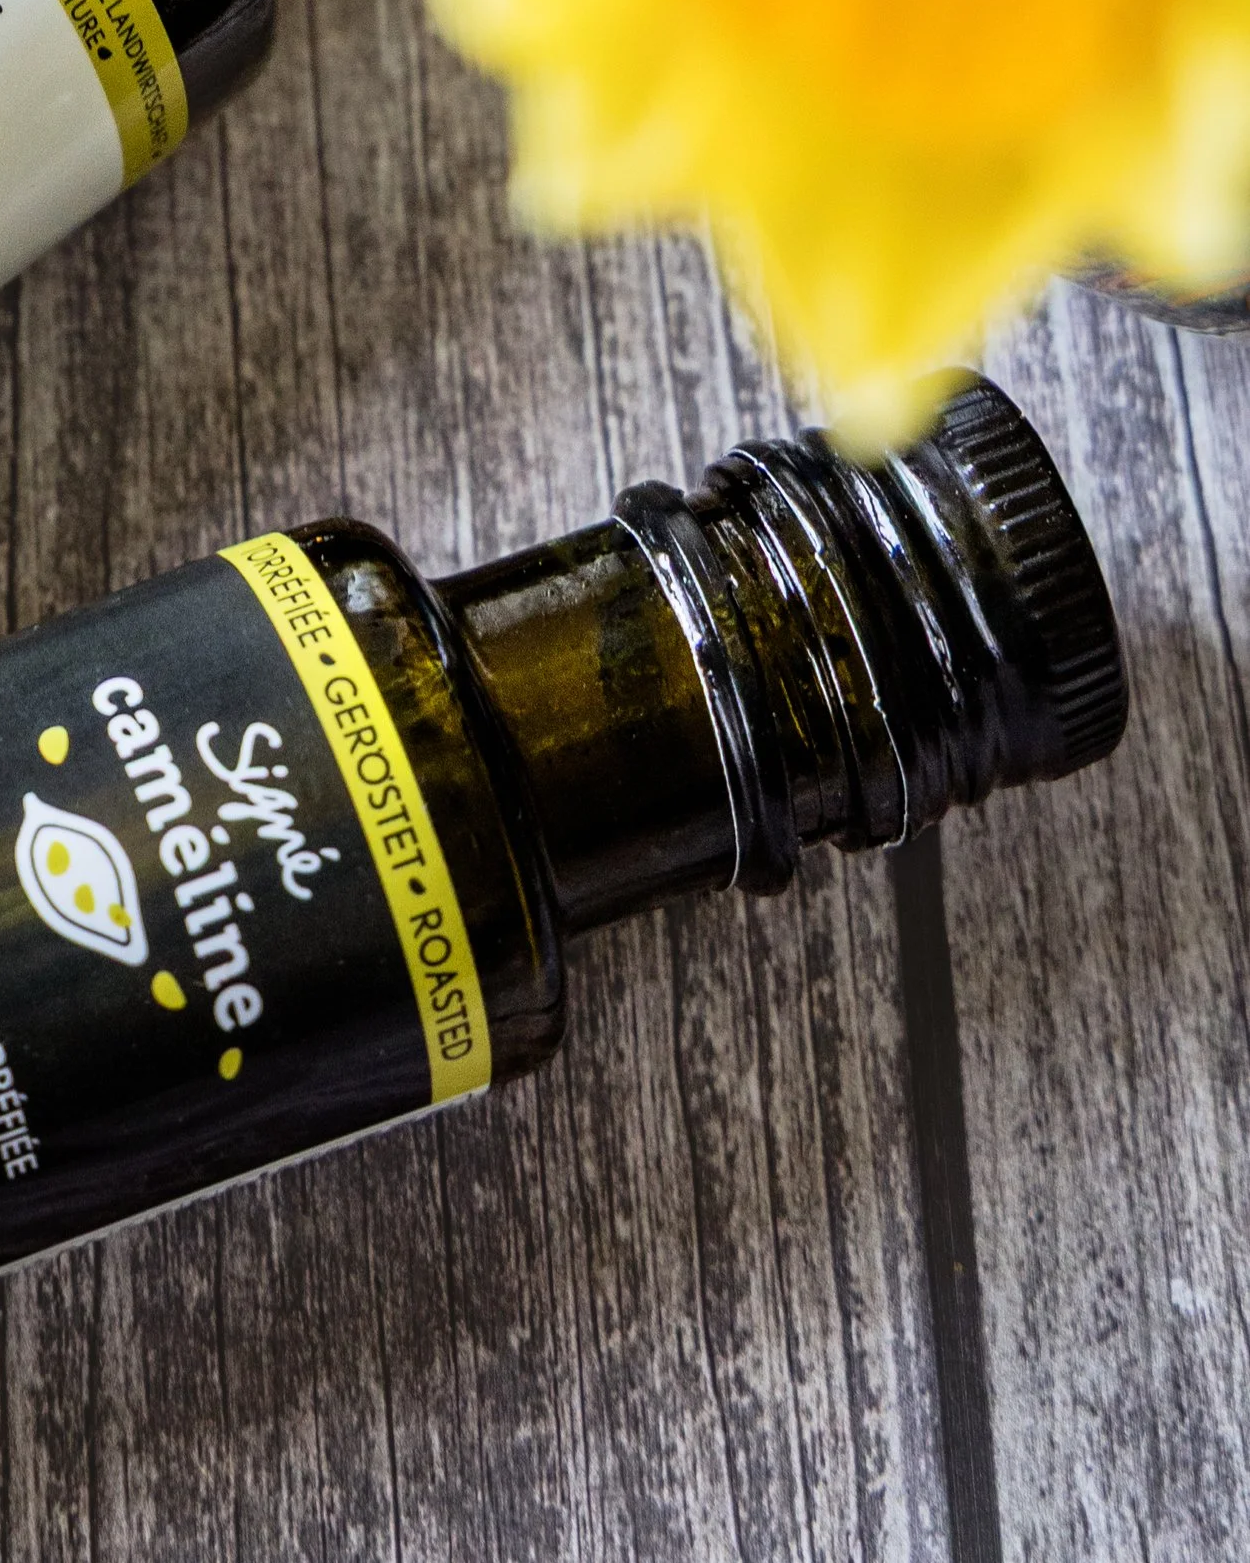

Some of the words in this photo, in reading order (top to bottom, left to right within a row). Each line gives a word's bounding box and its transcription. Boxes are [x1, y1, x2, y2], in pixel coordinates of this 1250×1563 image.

[92, 676, 265, 1032] caméline
[196, 720, 341, 901] Signé
[240, 541, 333, 650] TORRÉFIÉE
[323, 675, 427, 872] GERÖSTET
[409, 907, 474, 1063] ROASTED
